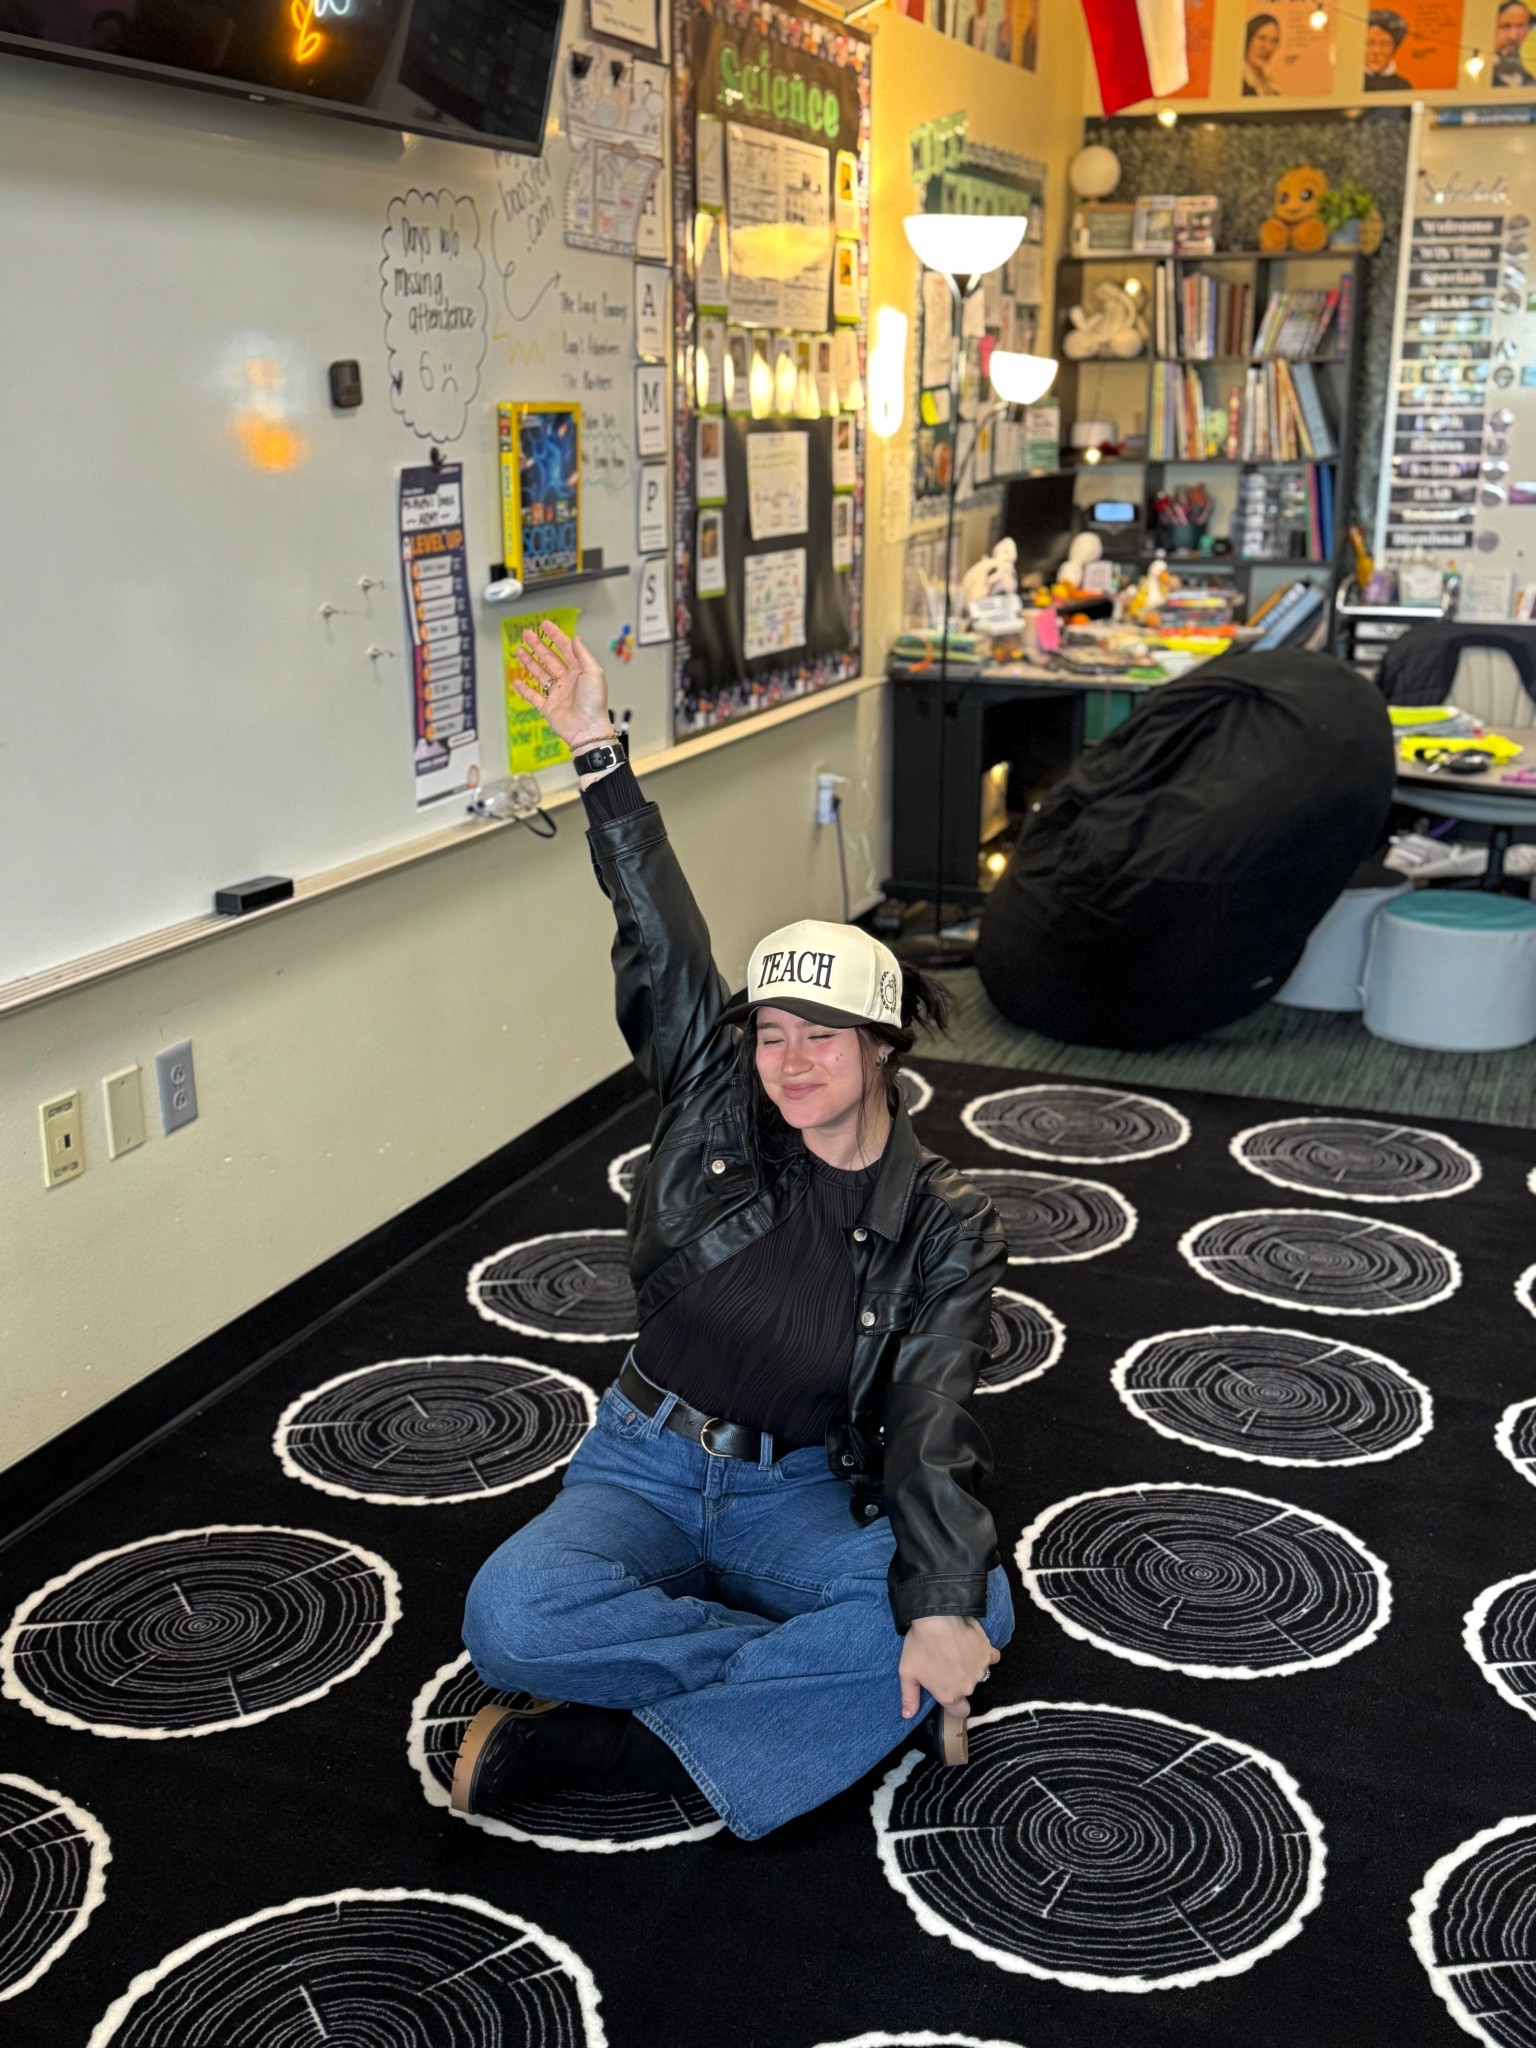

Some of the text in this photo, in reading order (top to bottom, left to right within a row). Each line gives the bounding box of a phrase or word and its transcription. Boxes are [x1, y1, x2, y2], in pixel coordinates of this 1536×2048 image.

[719, 45, 840, 138] Science
[419, 350, 435, 392] 6
[641, 382, 660, 415] M
[645, 480, 658, 512] P
[645, 574, 656, 605] S
[757, 950, 836, 990] TEACH
